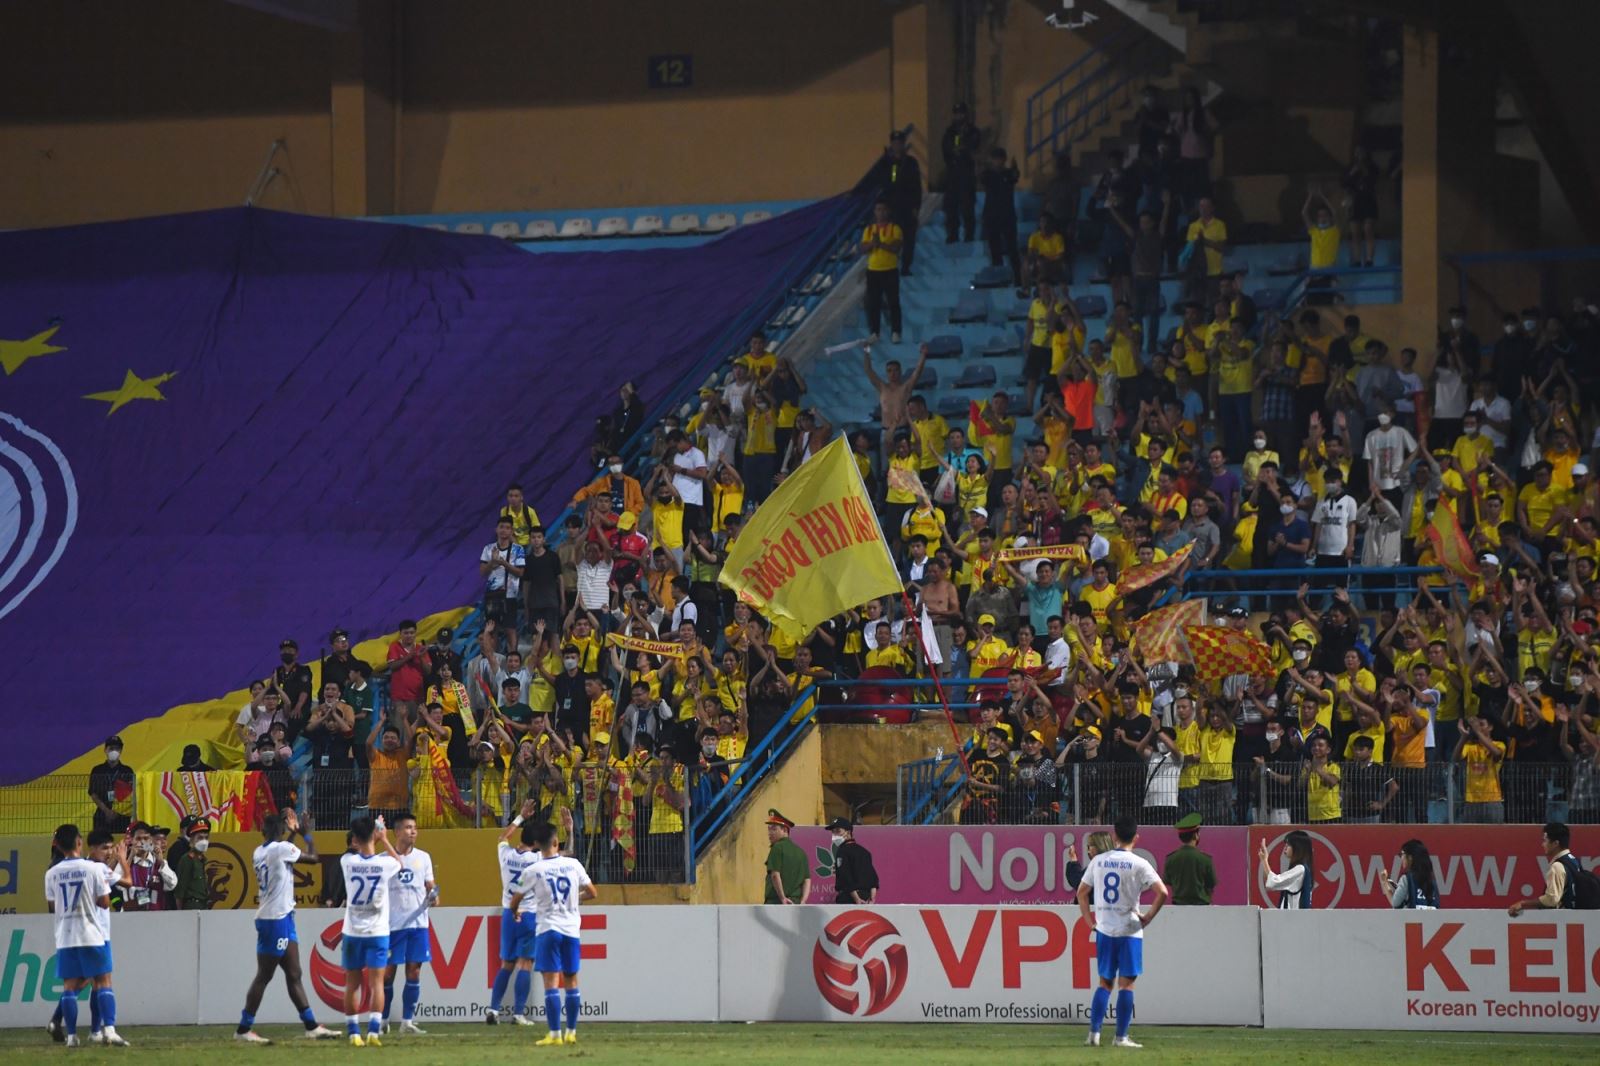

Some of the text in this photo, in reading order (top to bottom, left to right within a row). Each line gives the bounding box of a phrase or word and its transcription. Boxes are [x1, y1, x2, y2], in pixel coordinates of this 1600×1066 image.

[656, 60, 684, 83] 12
[950, 832, 1158, 891] Noli
[59, 880, 84, 912] 17
[350, 875, 381, 905] 27
[546, 876, 571, 904] 19
[1103, 872, 1120, 904] 8
[277, 937, 289, 950] 80
[1405, 922, 1600, 993] K-El
[413, 1003, 466, 1017] Vietnam
[921, 1002, 981, 1017] Vietnam
[985, 1002, 1072, 1019] Professional
[1407, 999, 1600, 1023] Korean Technology
